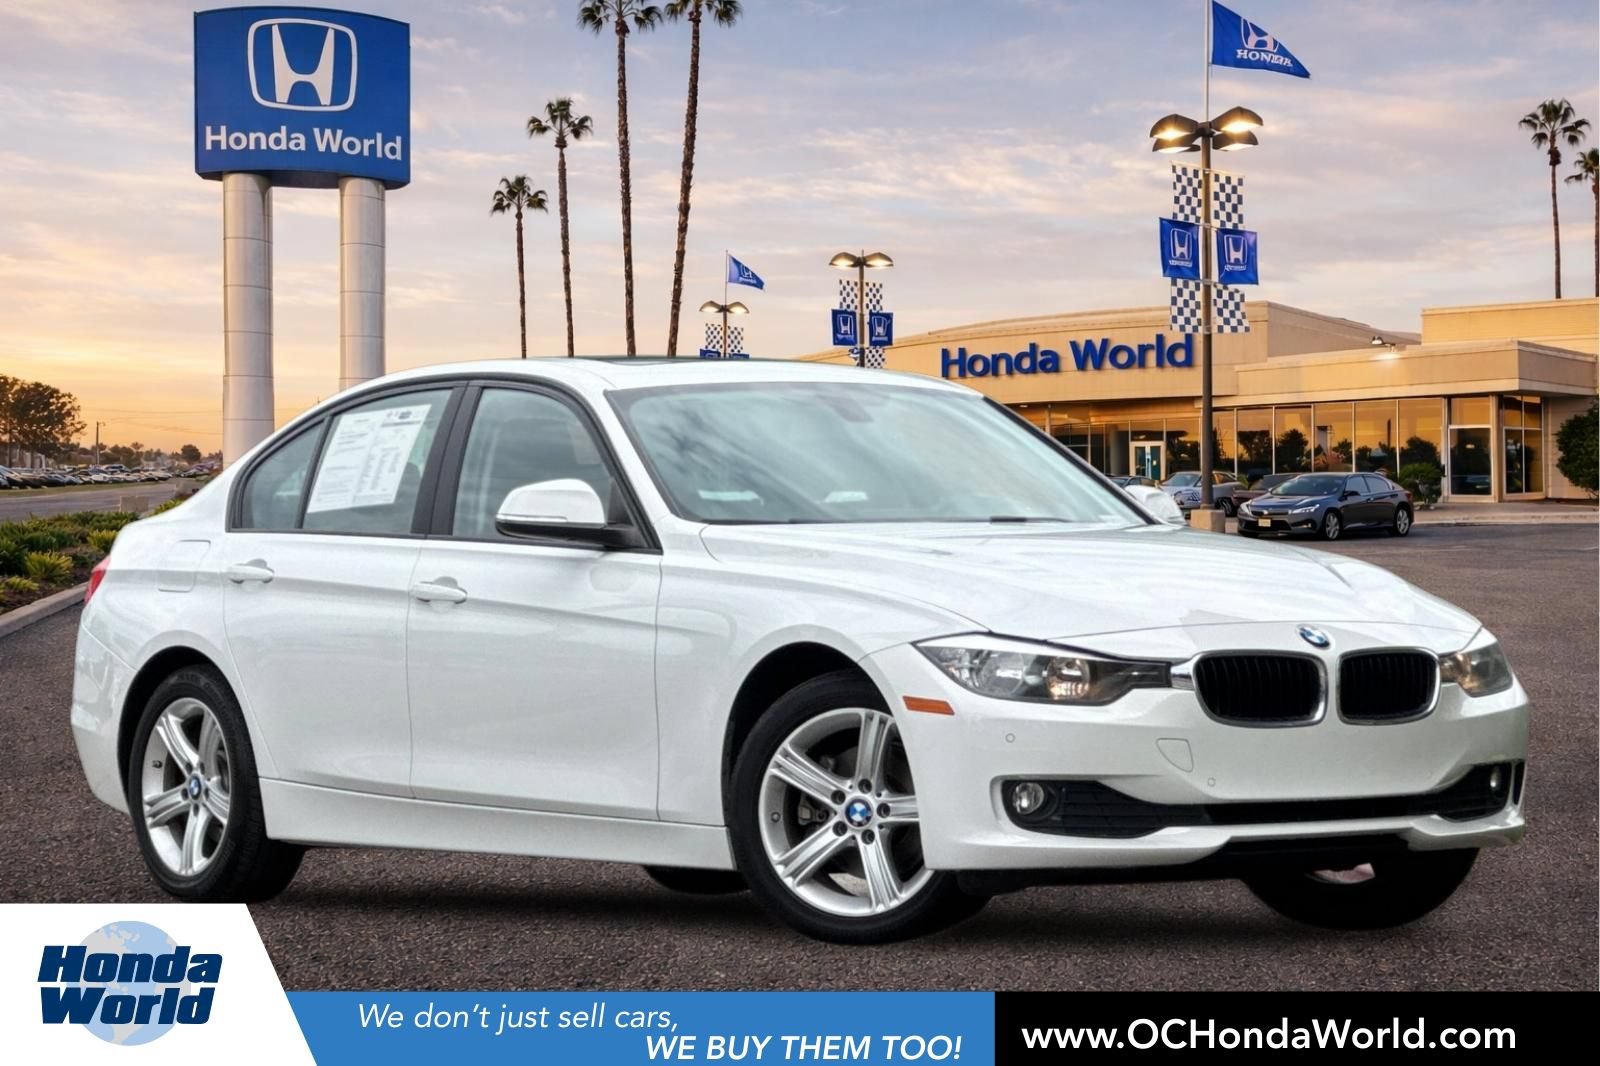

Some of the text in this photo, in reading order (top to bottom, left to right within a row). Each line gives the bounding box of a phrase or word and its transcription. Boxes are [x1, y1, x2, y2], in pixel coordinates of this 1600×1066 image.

[205, 125, 402, 161] Honda World
[941, 333, 1194, 378] Honda World
